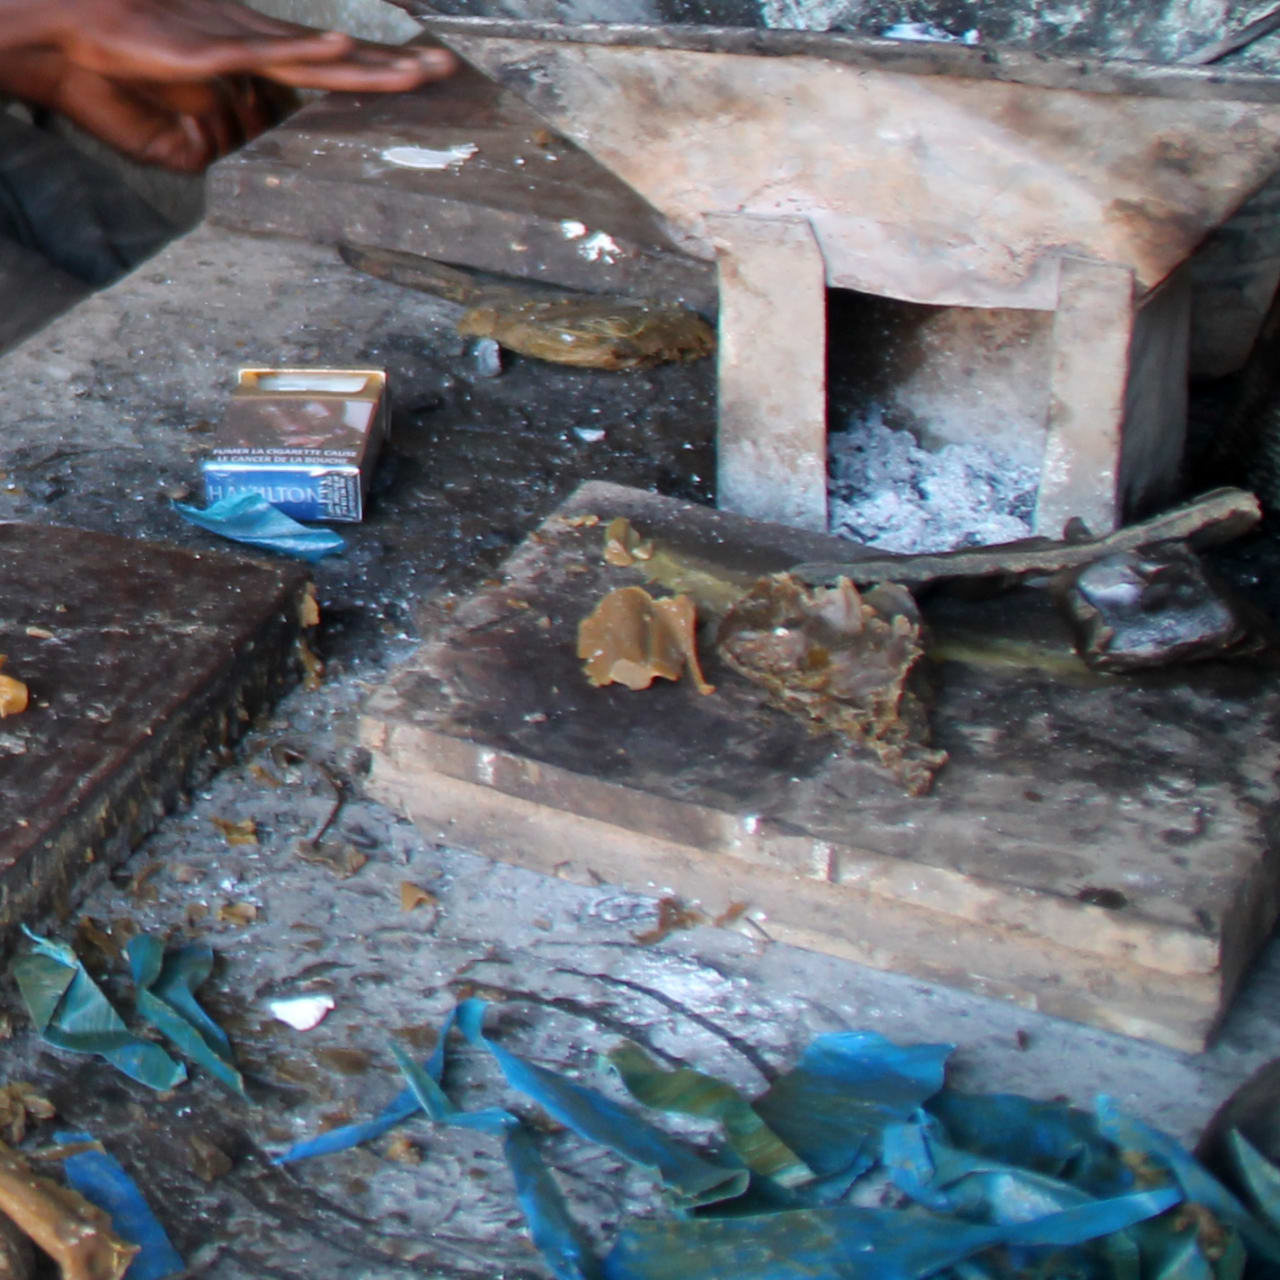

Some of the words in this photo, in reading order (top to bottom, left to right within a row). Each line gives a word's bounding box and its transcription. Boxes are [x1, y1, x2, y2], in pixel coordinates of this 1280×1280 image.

[266, 448, 322, 456] CIGARETTE
[324, 449, 357, 457] CAUSE
[305, 456, 348, 464] BOUCHE
